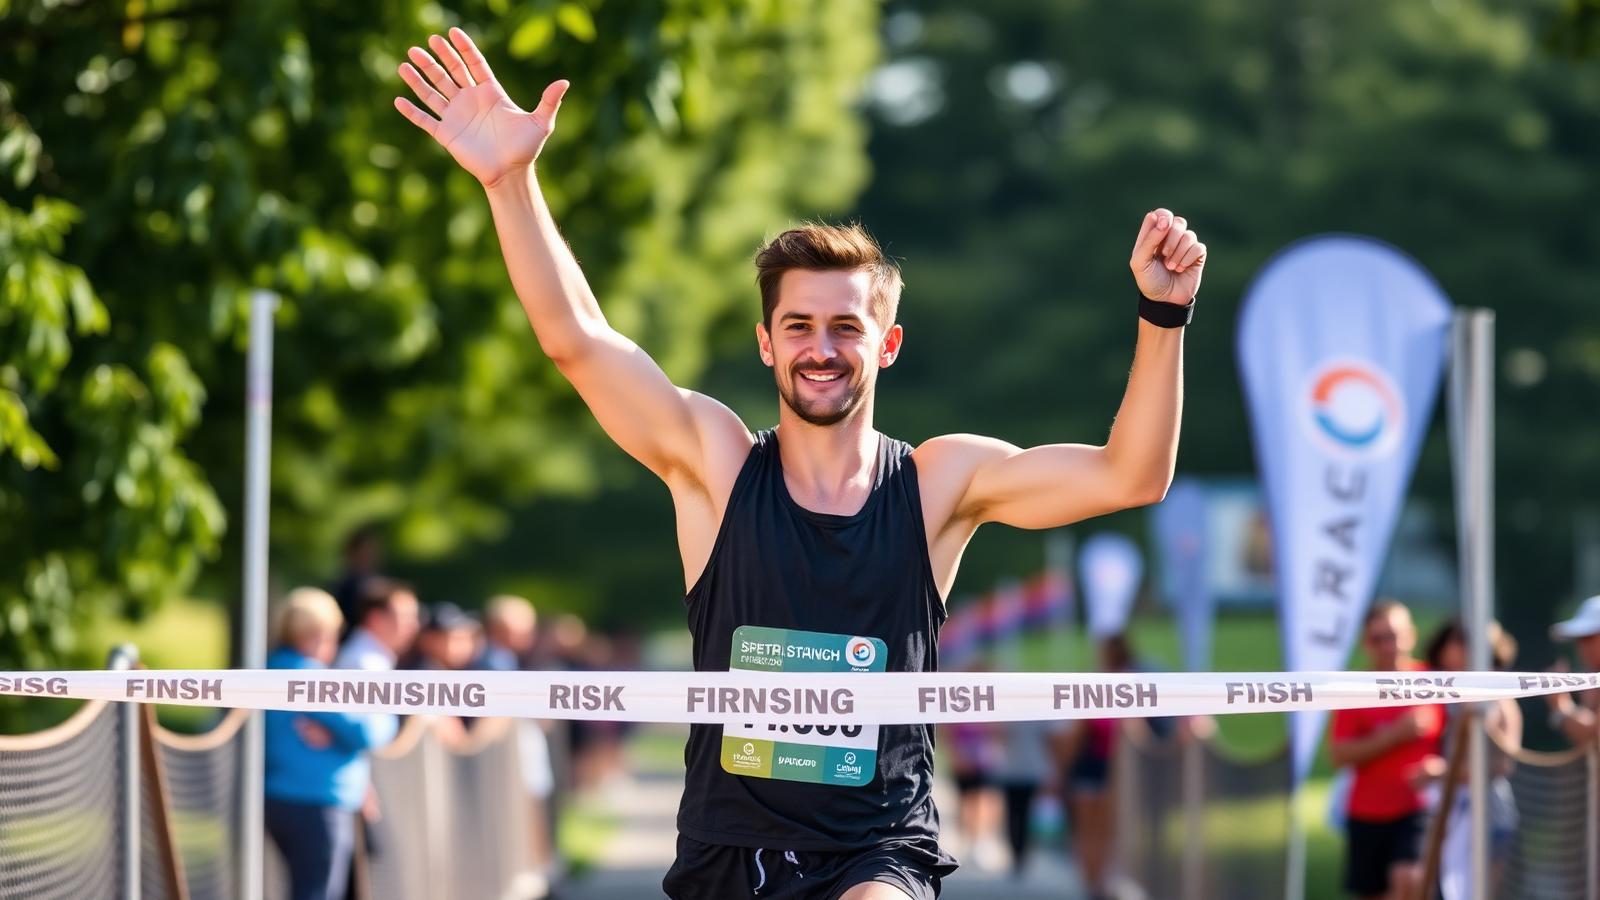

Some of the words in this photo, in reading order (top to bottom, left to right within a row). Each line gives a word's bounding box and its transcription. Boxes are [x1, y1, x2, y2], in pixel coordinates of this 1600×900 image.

[126, 678, 223, 701] FINSH
[286, 680, 486, 708] FIRNNISING
[549, 684, 626, 711] RISK
[686, 687, 855, 714] FIRNSING
[1053, 683, 1158, 710] FINISH
